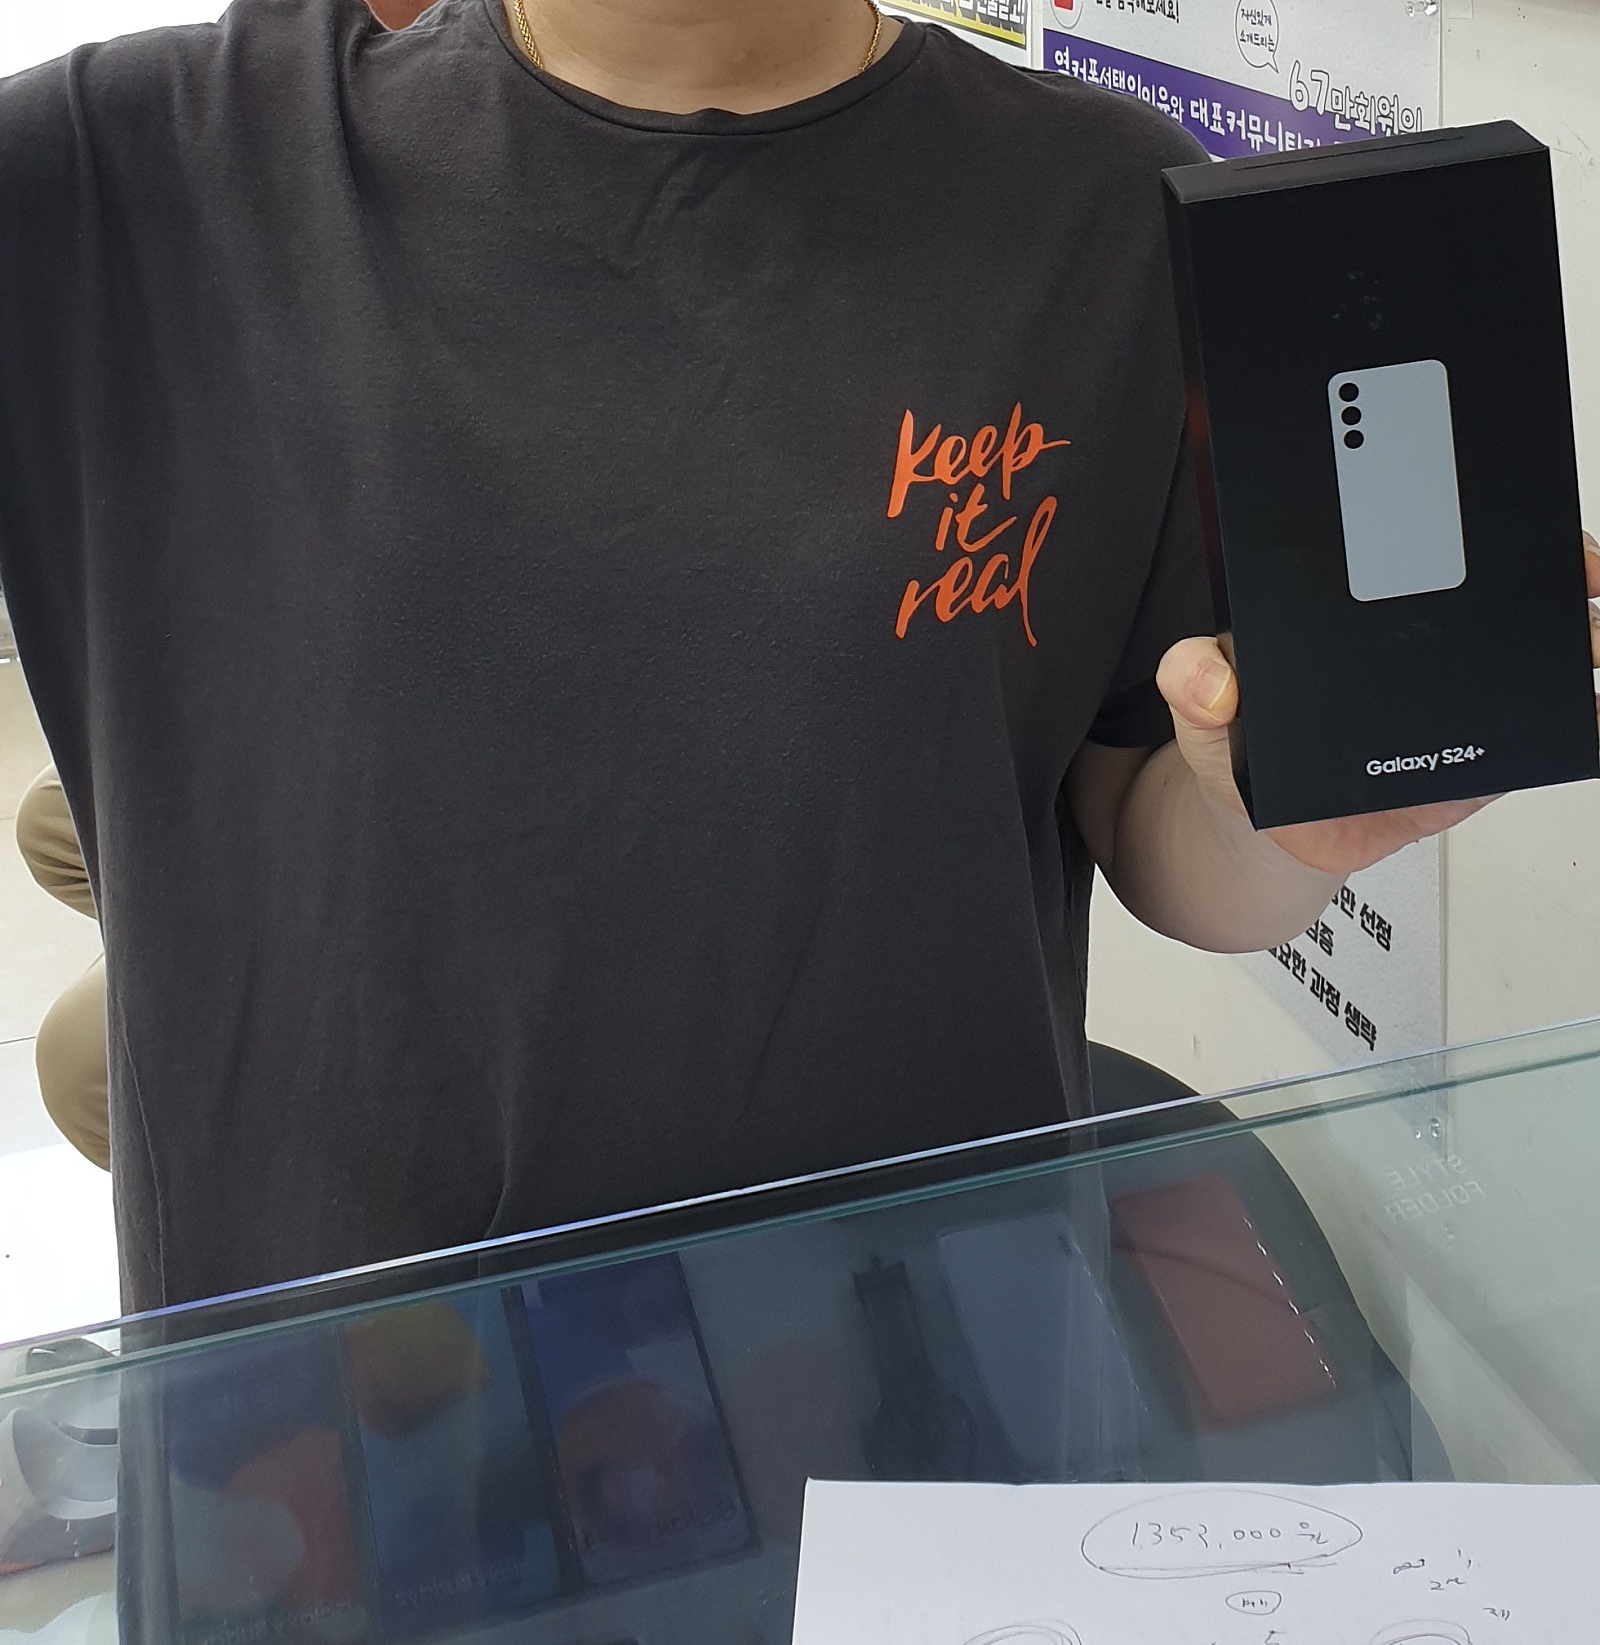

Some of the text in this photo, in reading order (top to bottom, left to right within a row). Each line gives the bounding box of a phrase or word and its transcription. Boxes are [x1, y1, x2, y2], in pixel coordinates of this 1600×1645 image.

[1239, 32, 1276, 53] 소개드리는
[1240, 7, 1273, 27] 자신있게
[935, 483, 1018, 552] it
[895, 495, 1058, 648] real
[1366, 745, 1486, 776] Galaxy S24+
[1331, 885, 1392, 952] 만 선정
[1268, 942, 1377, 1052] 요한 과정 생략
